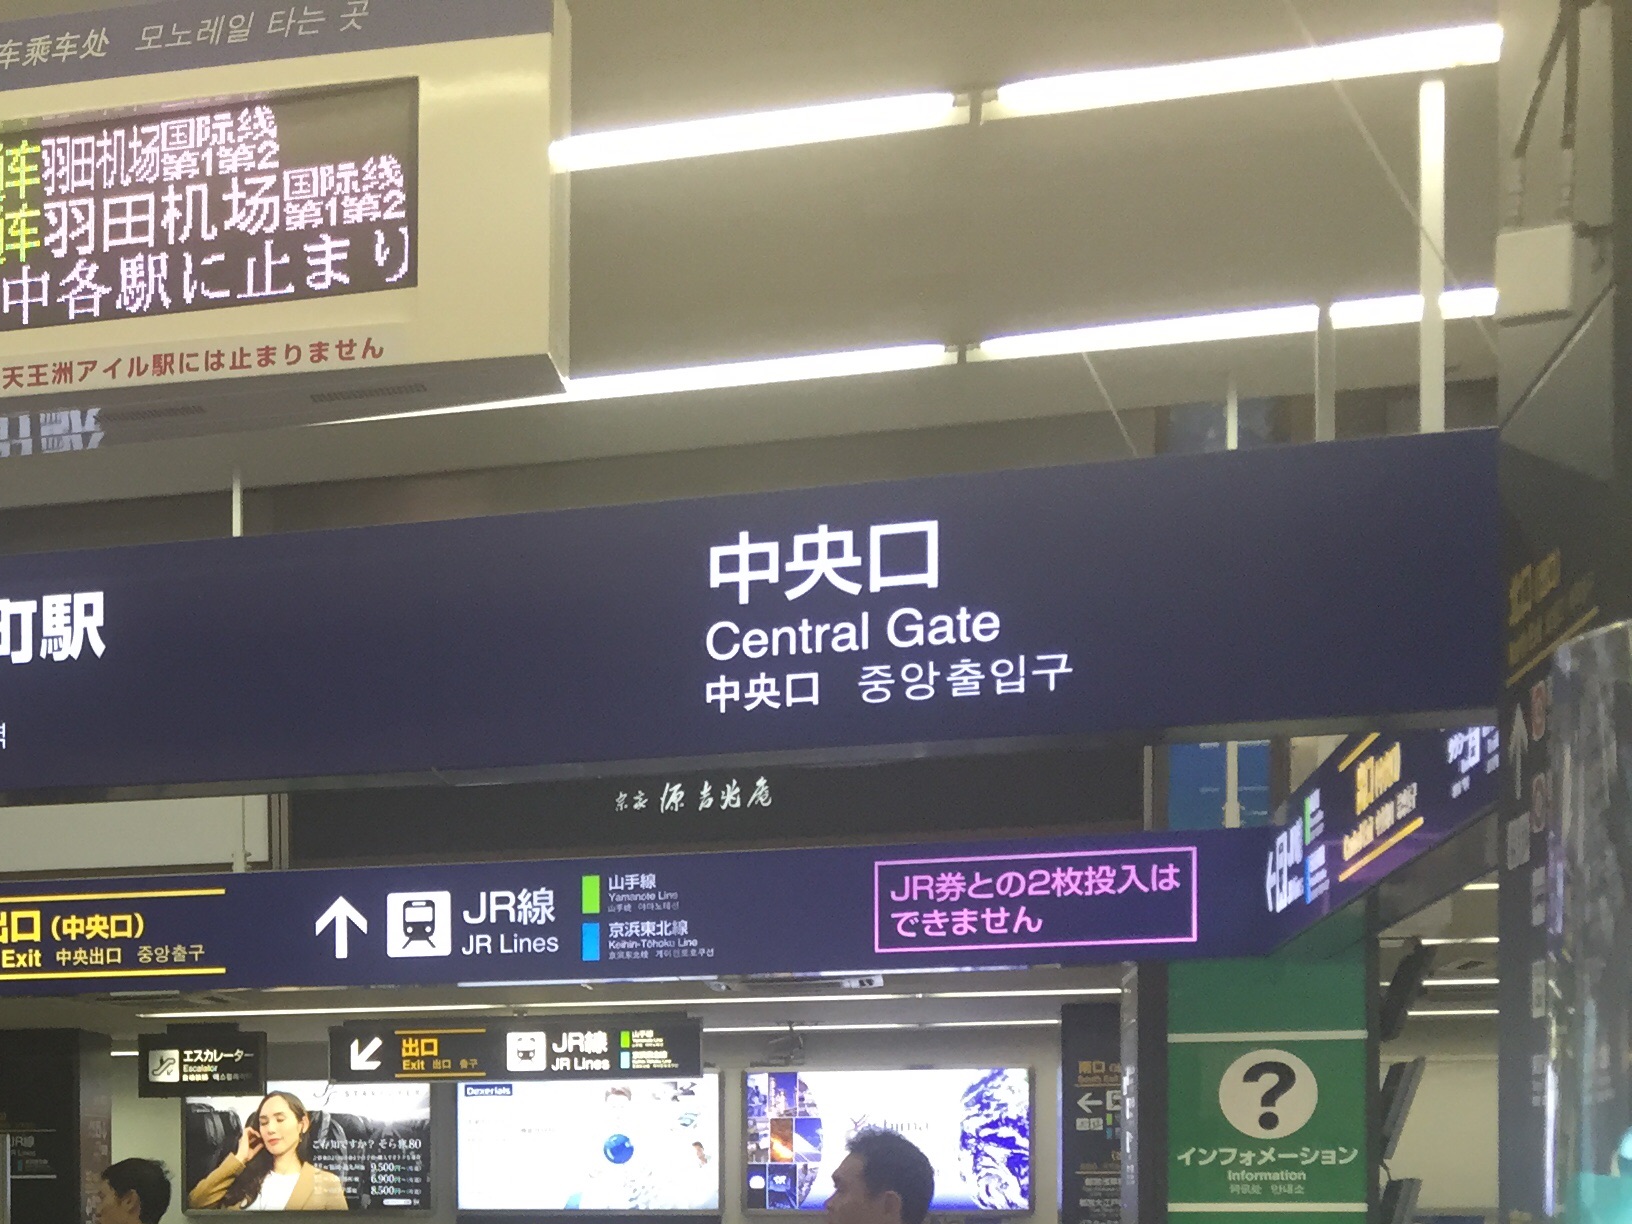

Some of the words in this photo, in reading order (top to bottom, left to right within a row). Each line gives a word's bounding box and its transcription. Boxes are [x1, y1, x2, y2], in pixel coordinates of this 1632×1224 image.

[135, 12, 255, 51] 모노레일
[267, 3, 326, 37] 타는
[340, 0, 370, 33] 곳
[709, 520, 940, 605] 中央口
[706, 611, 870, 662] Central
[886, 605, 1001, 649] Gate
[706, 673, 820, 713] 中央口
[858, 652, 1074, 704] 중앙출입구
[608, 873, 657, 891] 山手線
[890, 863, 1181, 905] JR券との2枚投入は
[462, 887, 556, 926] JR線
[608, 893, 656, 902] Yamanote
[658, 891, 679, 901] Line
[608, 919, 689, 938] 京浜東北線
[890, 905, 1044, 938] できません
[462, 935, 492, 955] JR
[500, 932, 559, 954] Lines
[677, 938, 699, 947] Line
[1, 949, 42, 969] Exit
[56, 947, 123, 966] 中央出口
[137, 943, 206, 964] 중앙출구
[402, 1037, 439, 1057] 出口
[551, 1031, 608, 1055] JR線
[183, 1049, 254, 1062] エスカレーター
[402, 1059, 426, 1070] Exit
[551, 1057, 571, 1071] JR
[575, 1057, 611, 1071] Lines
[1177, 1147, 1359, 1166] インフォメーション
[1227, 1170, 1307, 1181] Information
